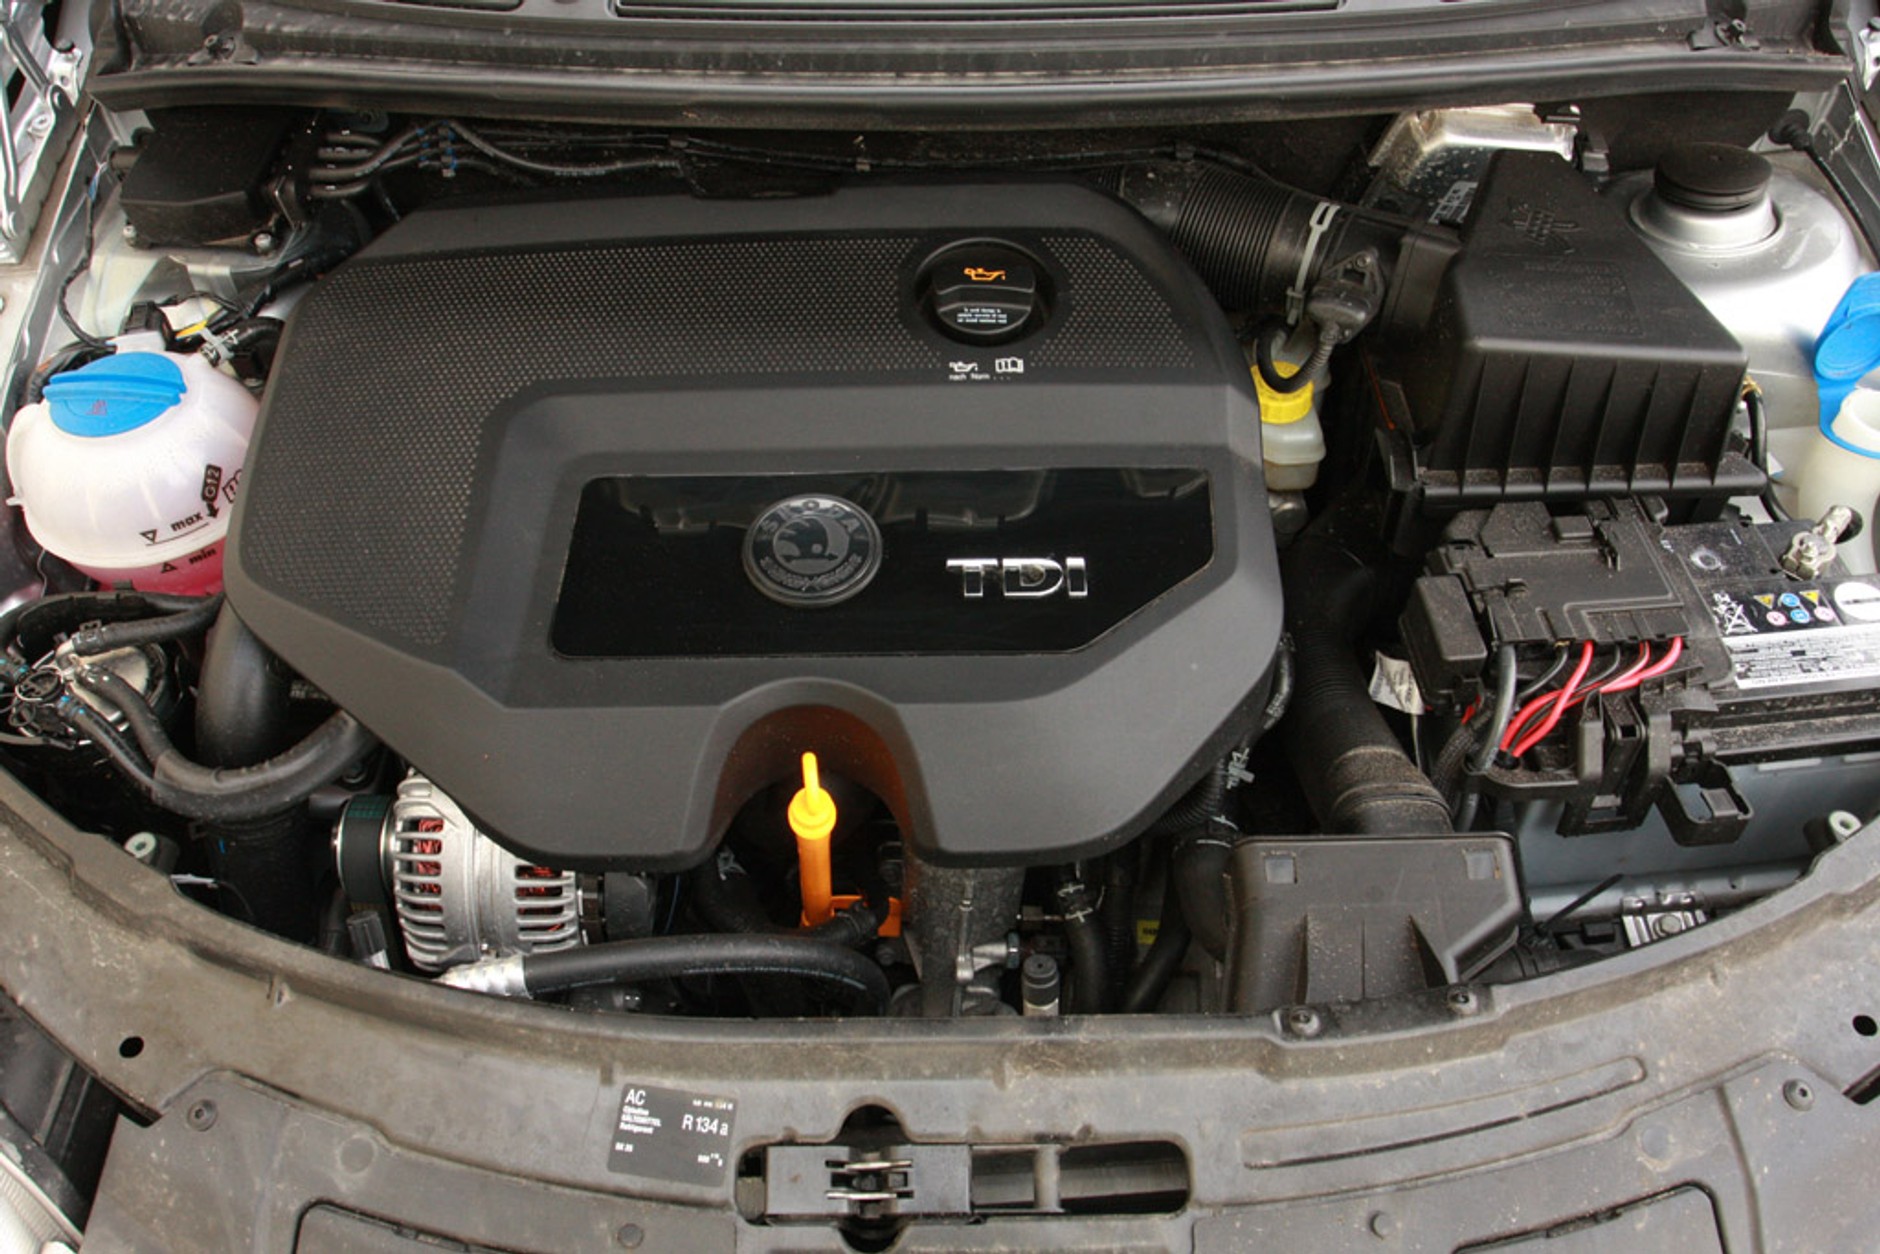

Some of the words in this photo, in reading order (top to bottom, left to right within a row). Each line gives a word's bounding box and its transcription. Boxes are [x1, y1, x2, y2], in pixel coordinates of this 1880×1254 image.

[204, 468, 220, 499] G12
[170, 511, 204, 531] max
[188, 547, 218, 565] min
[946, 557, 1088, 597] TDI
[624, 1088, 646, 1106] AC
